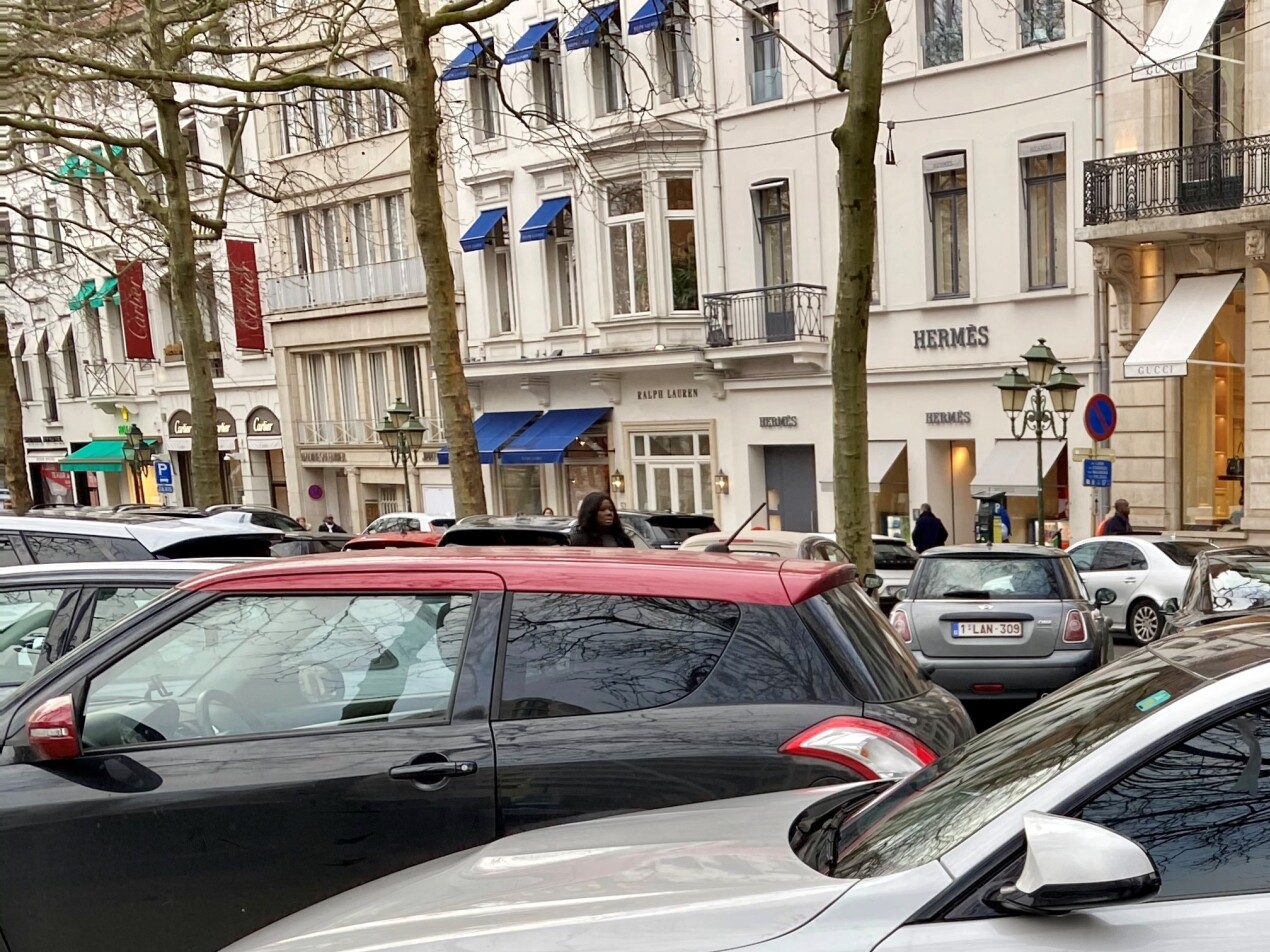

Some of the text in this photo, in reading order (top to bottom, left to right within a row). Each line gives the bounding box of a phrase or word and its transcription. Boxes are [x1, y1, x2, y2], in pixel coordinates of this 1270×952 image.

[128, 276, 148, 340] Cartier
[913, 323, 990, 350] HERMÈS
[1137, 364, 1174, 375] GUCCI
[637, 388, 699, 400] RALPH LAUREN
[253, 416, 274, 432] Cartier
[925, 409, 972, 424] HERMÈS
